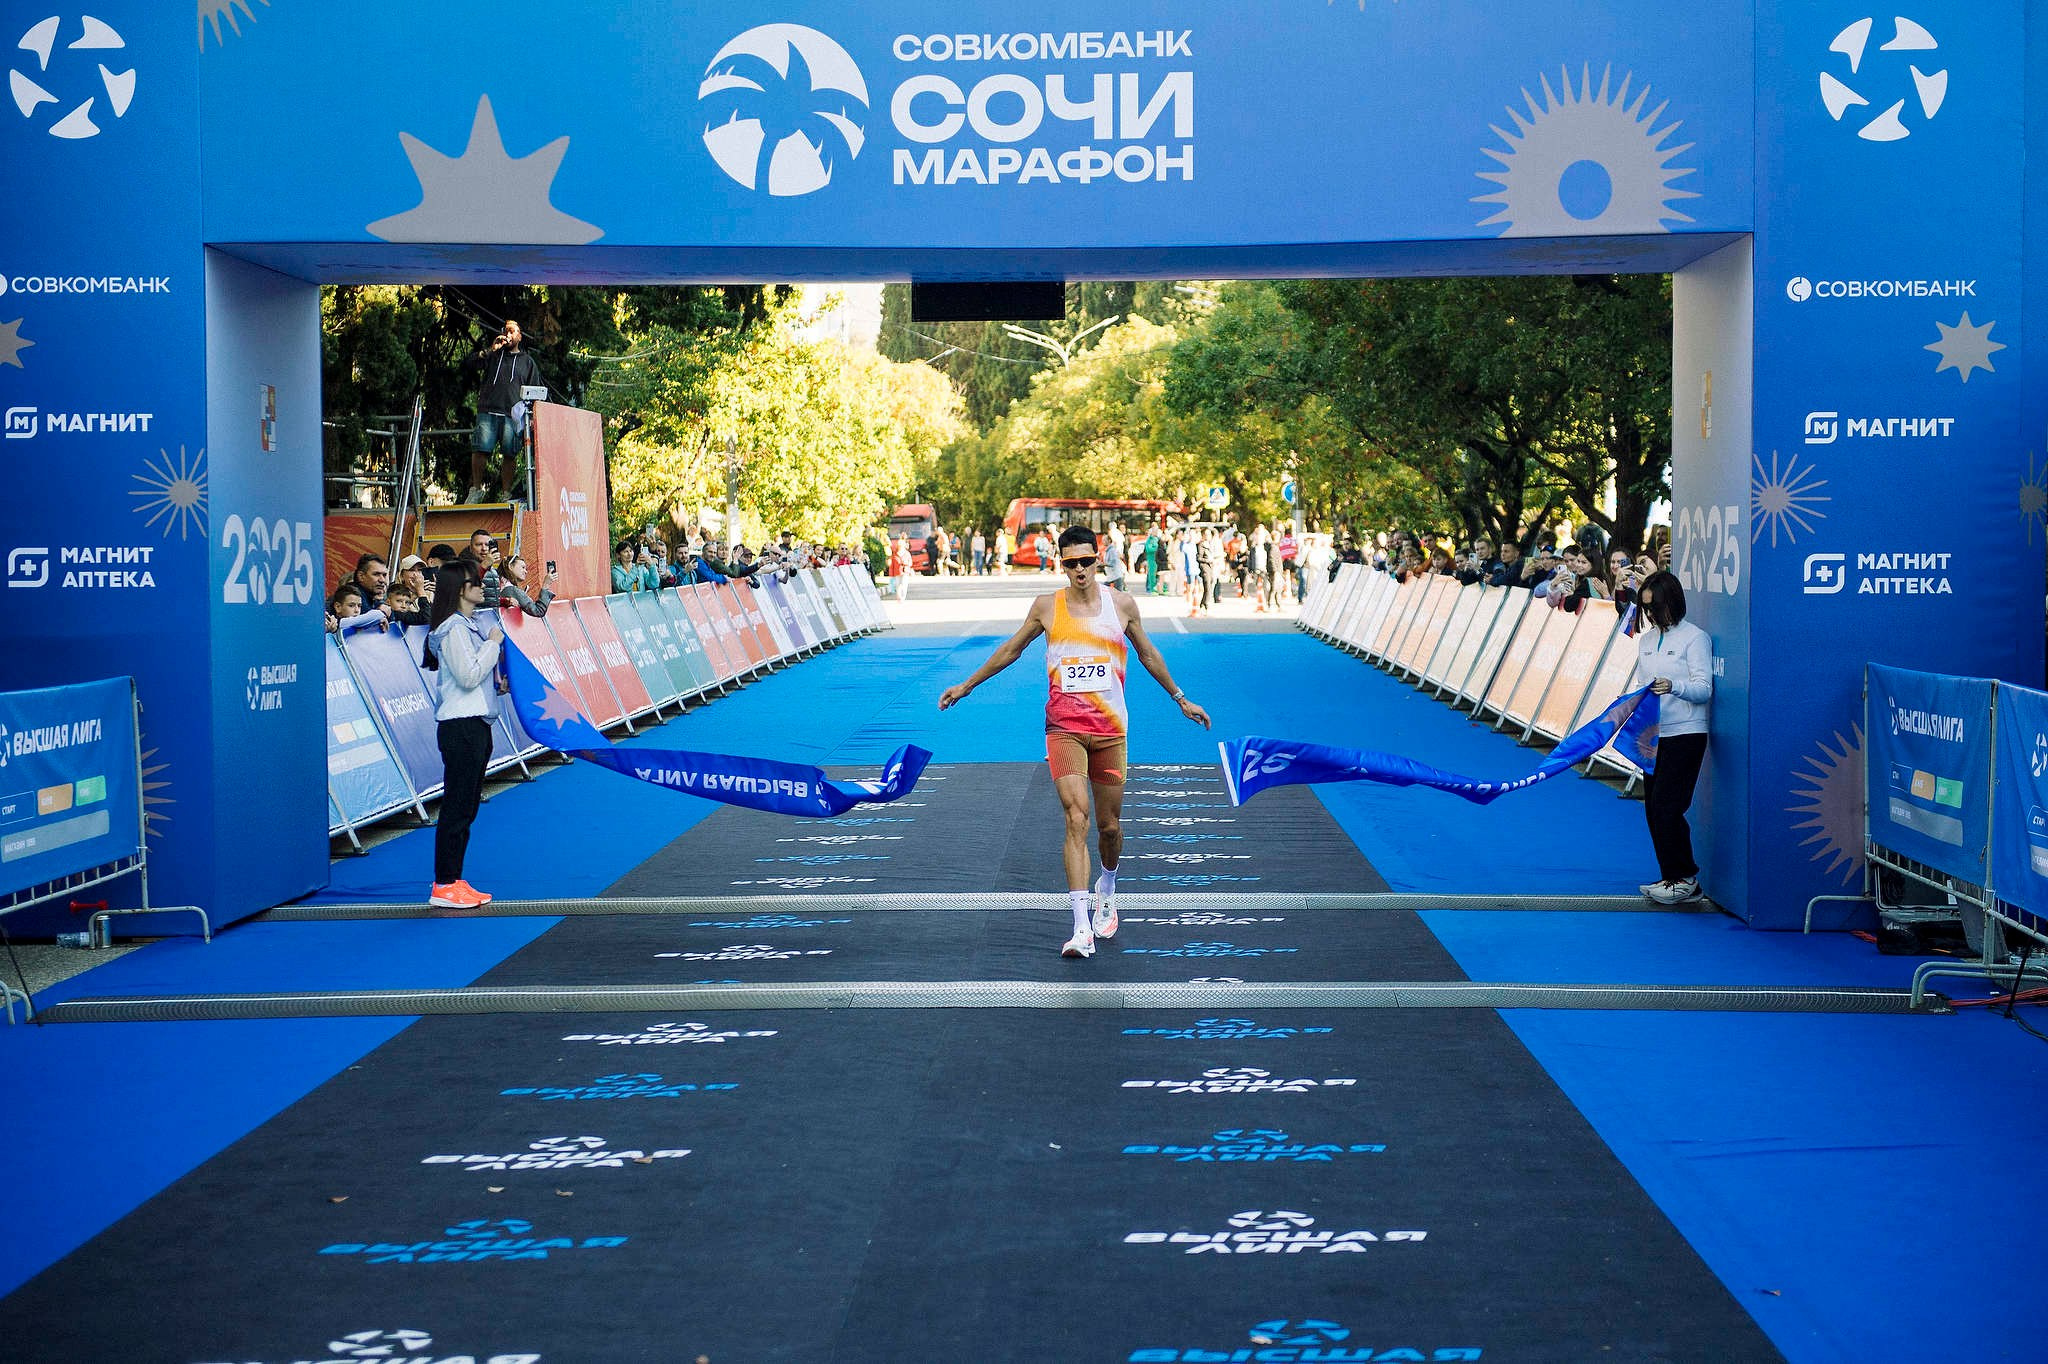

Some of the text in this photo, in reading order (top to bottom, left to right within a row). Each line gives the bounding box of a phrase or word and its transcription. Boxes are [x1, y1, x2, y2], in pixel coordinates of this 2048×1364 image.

[892, 29, 1193, 62] СОВКОМБАНК
[890, 71, 1194, 144] СОЧИ
[893, 144, 1194, 185] МАРАФОН
[11, 276, 171, 294] СОВКОМБАНК
[1815, 279, 1977, 298] СОВКОМБАНК
[47, 413, 153, 432] МАГНИТ
[1847, 418, 1955, 437] МАГНИТ
[60, 546, 154, 564] МАГНИТ
[222, 514, 314, 605] 2025
[1677, 505, 1740, 596] 2025
[1857, 552, 1952, 570] МАГНИТ
[61, 571, 156, 588] АПТЕКА
[1858, 577, 1953, 595] АПТЕКА
[260, 663, 297, 685] ВЫСШАЯ
[1067, 665, 1106, 679] 3278
[259, 690, 283, 711] ЛИГА
[13, 718, 102, 756] ВЫСШАЯ ЛИГА
[635, 767, 808, 798] ВЫСШАЯ ЛИГА
[1121, 1079, 1357, 1087] ВЫСШАЯ
[421, 1149, 692, 1163] ВЫСШАЯ
[1121, 1144, 1387, 1154] ВЫСШАЯ
[1175, 1152, 1333, 1161] ЛИГА
[464, 1159, 624, 1170] ЛИГА
[317, 1236, 628, 1254] ВЫСШАЯ
[1123, 1230, 1428, 1243] ВЫСШАЯ
[1185, 1241, 1367, 1254] ЛИГА
[365, 1250, 548, 1264] ЛИГА
[1128, 1347, 1483, 1363] ВЫСШАЯ
